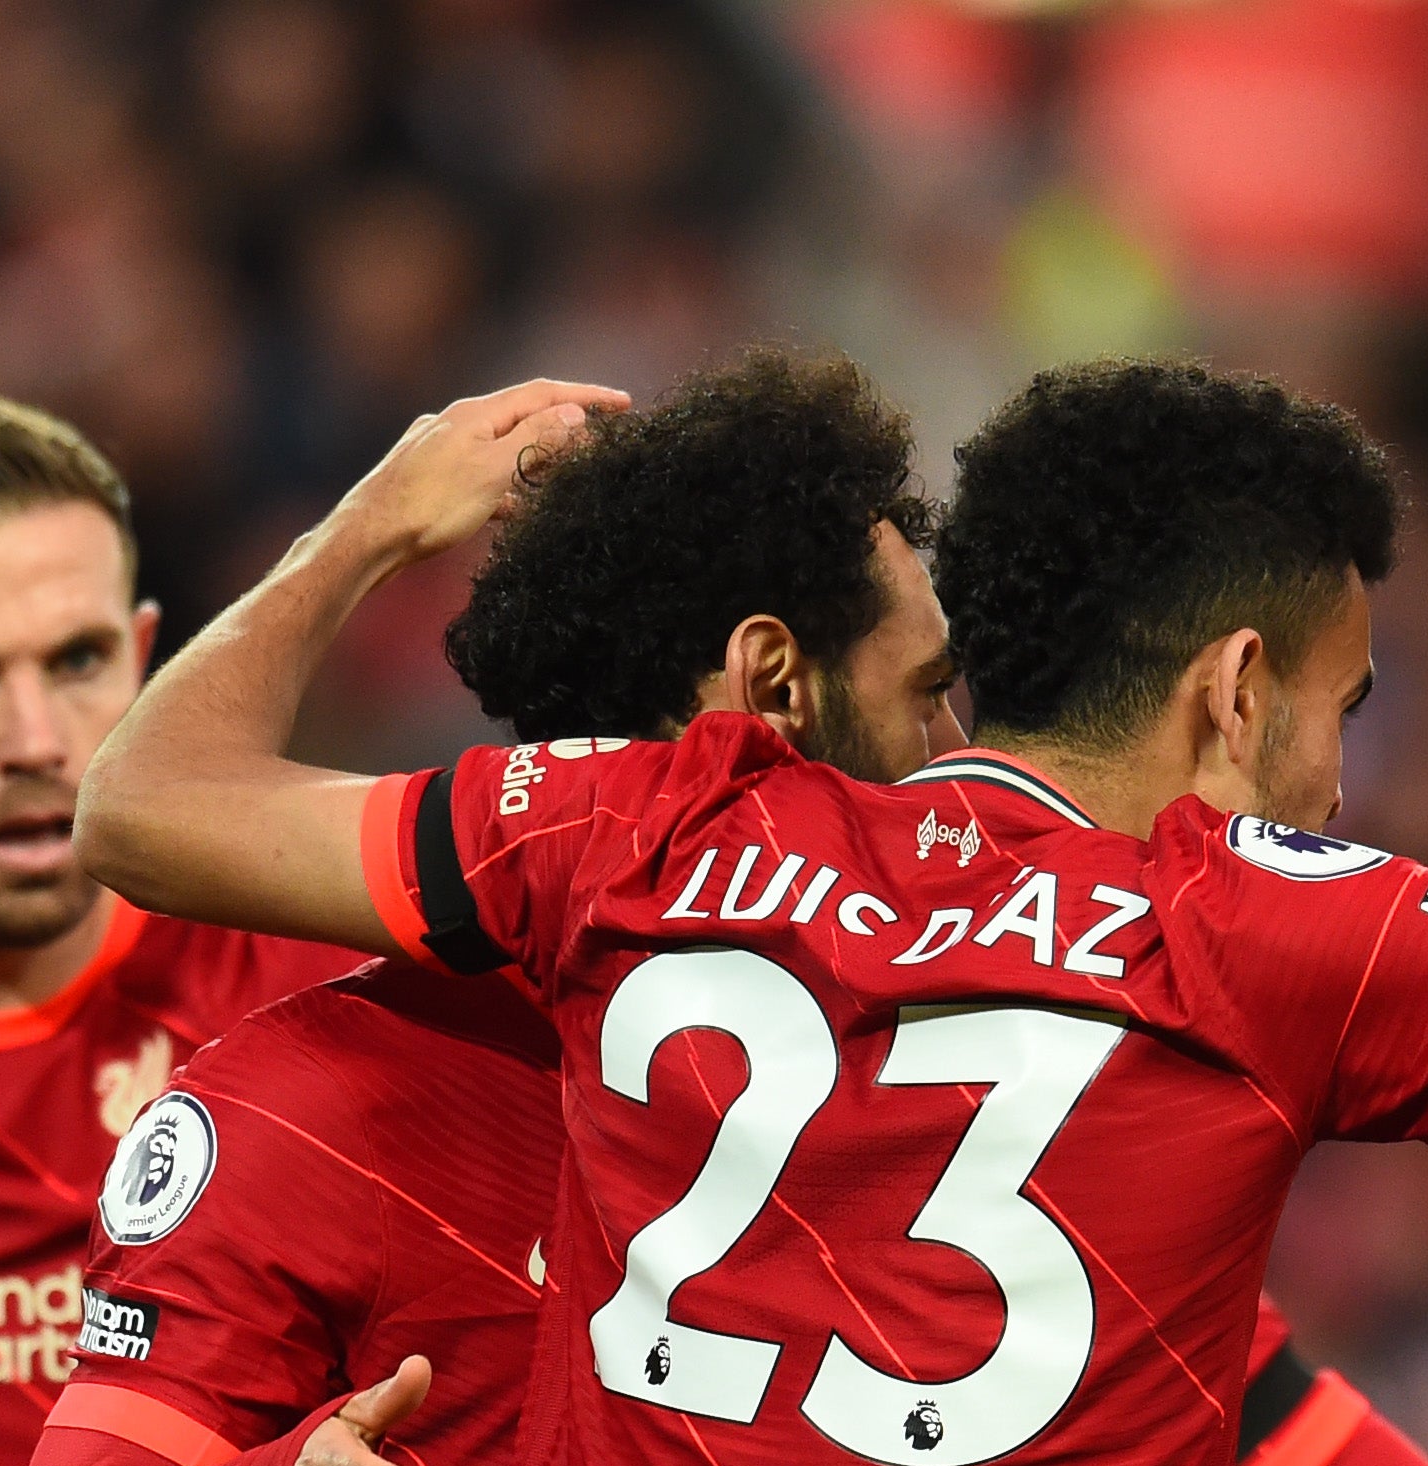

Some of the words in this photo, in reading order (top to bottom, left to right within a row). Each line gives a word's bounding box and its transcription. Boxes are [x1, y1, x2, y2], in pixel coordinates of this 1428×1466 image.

[499, 742, 547, 816] edia
[936, 824, 961, 846] 96
[889, 865, 1152, 979] DAZ
